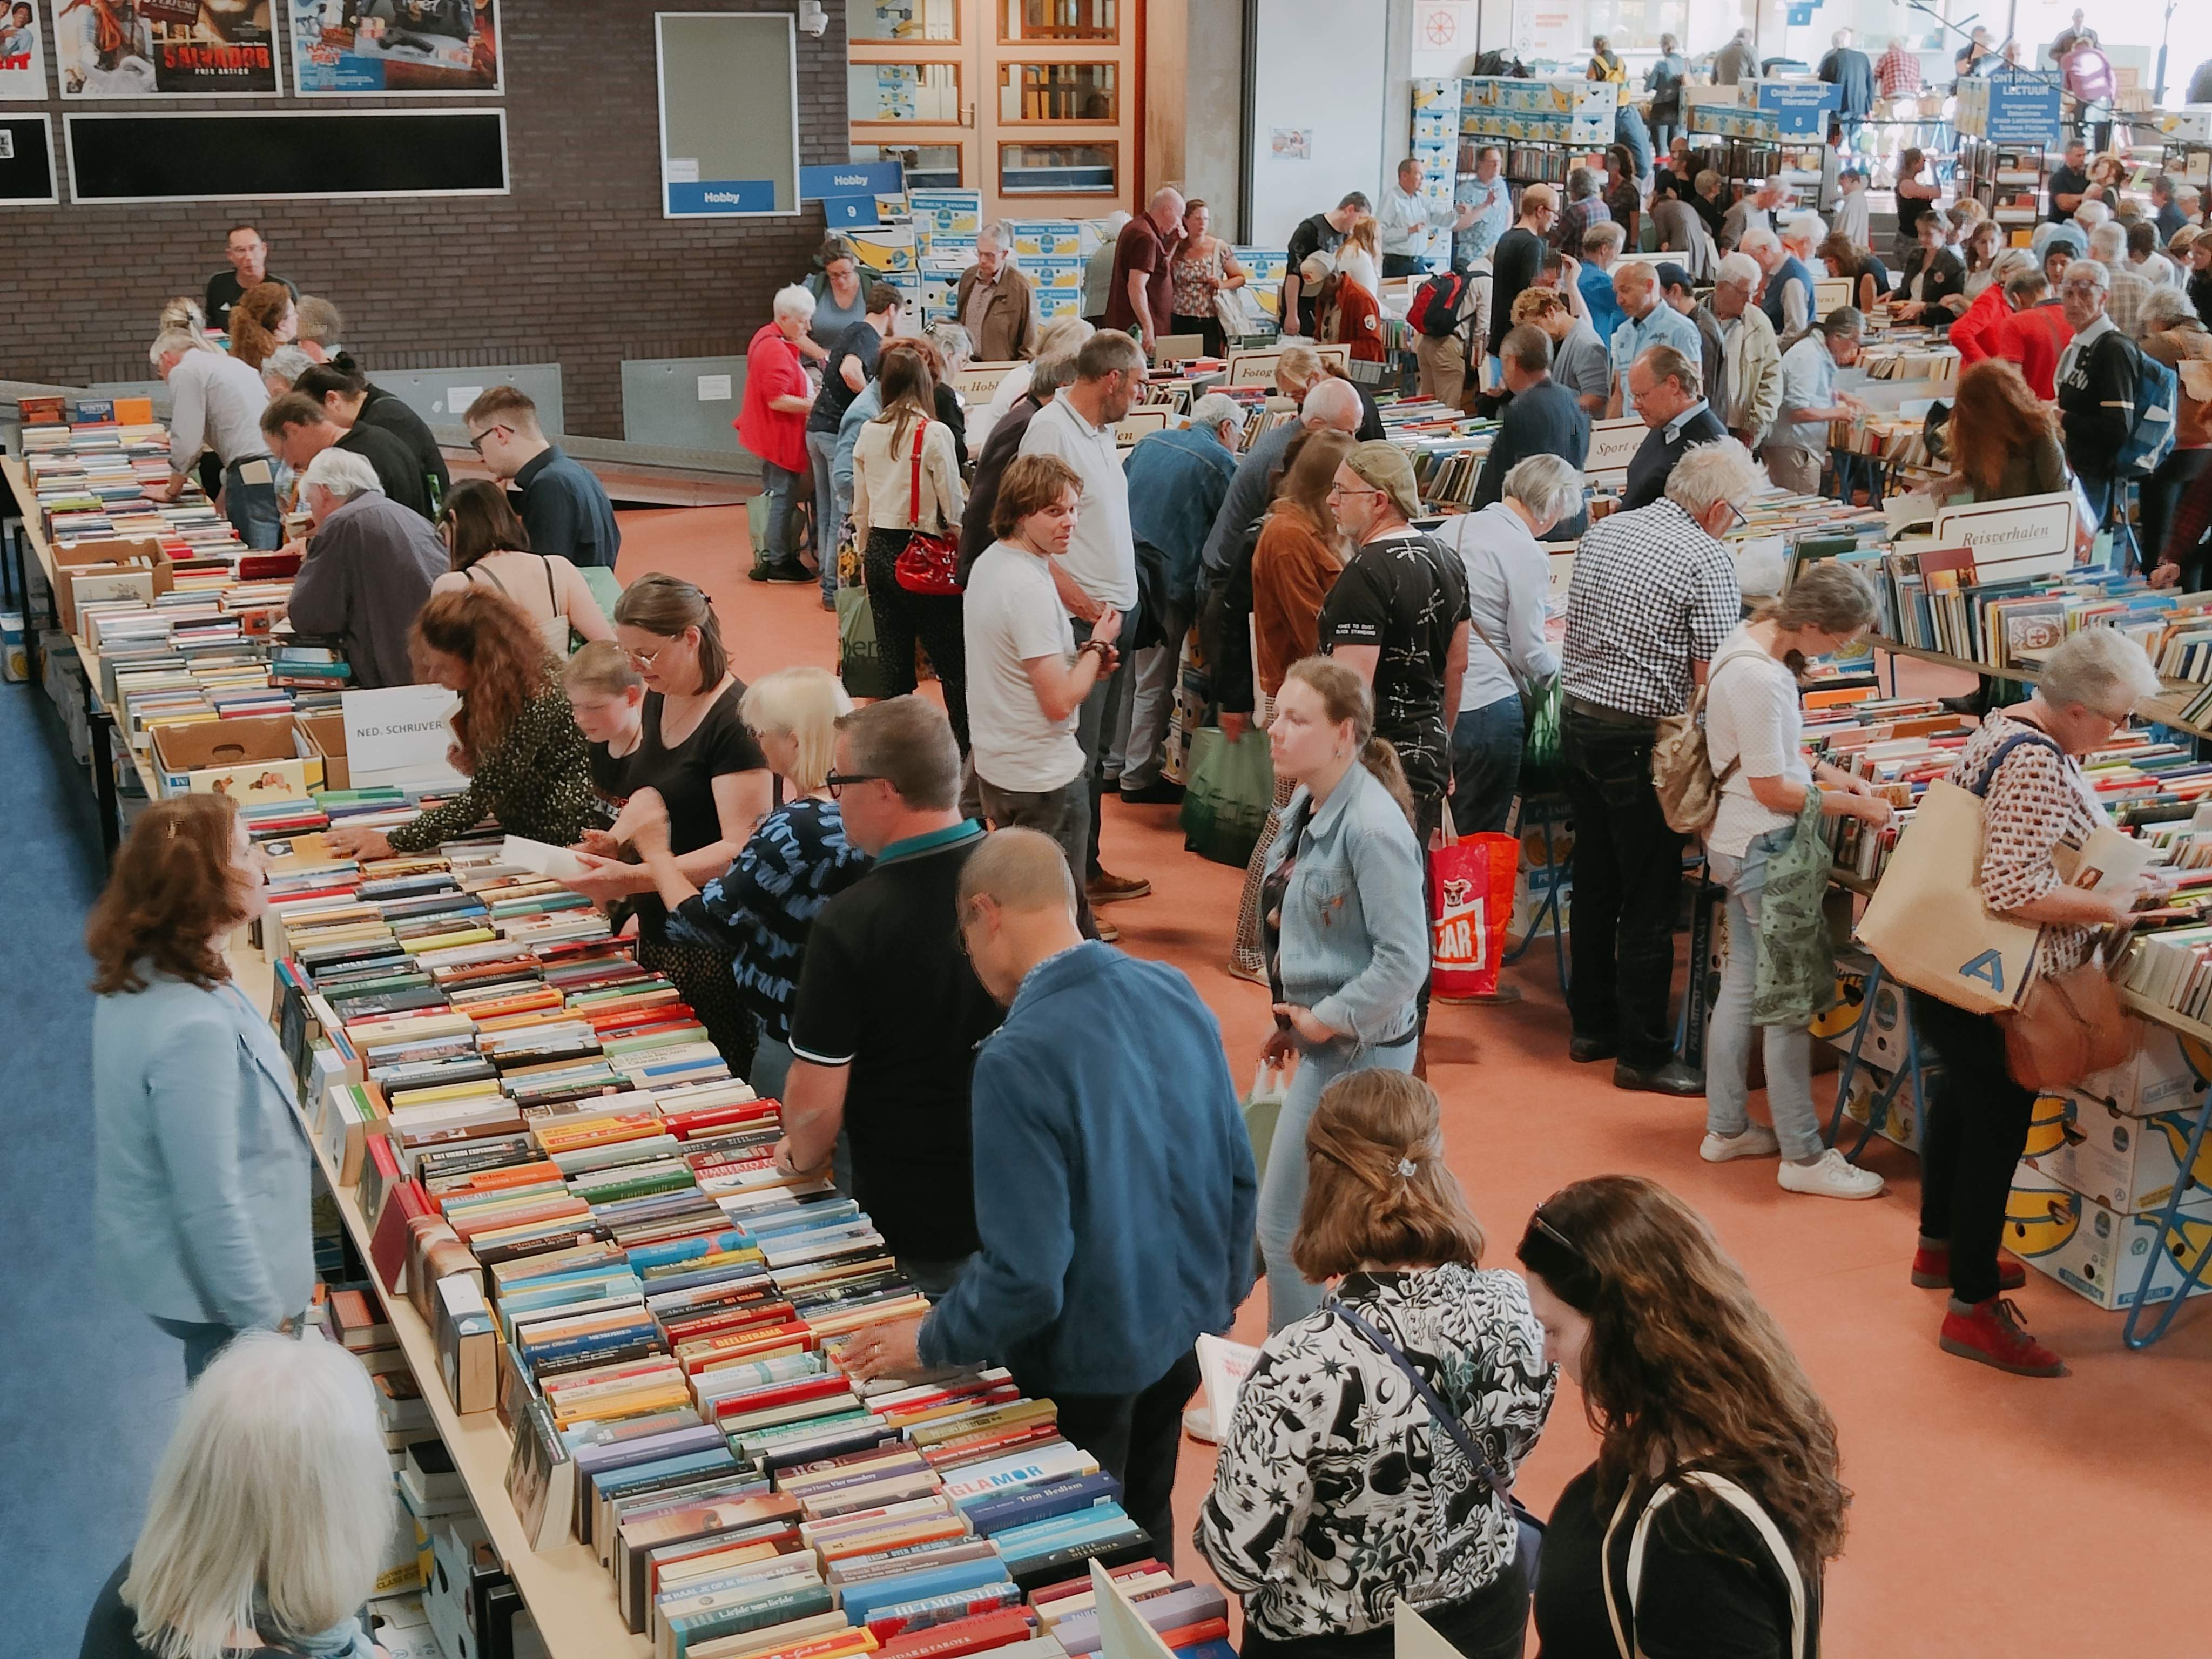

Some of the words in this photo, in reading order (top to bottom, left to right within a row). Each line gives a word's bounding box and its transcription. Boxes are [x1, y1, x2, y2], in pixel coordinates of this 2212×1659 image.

[834, 174, 868, 186] Hobby
[704, 192, 740, 204] Hobby
[847, 205, 857, 217] 9
[1241, 367, 1275, 380] Fotog
[1597, 441, 1629, 455] Sport
[1962, 523, 2049, 547] Reisverhalen
[356, 727, 383, 738] NED.
[386, 721, 442, 734] SCHRIJVER
[1437, 919, 1472, 959] ZAR
[698, 1161, 759, 1176] UMBERTO
[686, 1301, 720, 1312] Garland
[715, 1328, 783, 1348] DEELDERAMA
[830, 1479, 846, 1487] Vier
[1017, 1494, 1042, 1503] Tom
[1043, 1482, 1083, 1497] Bedlam
[673, 1587, 699, 1598] HAAL
[699, 1585, 711, 1593] JE
[711, 1582, 725, 1591] OP,
[725, 1580, 736, 1588] IK
[718, 1605, 751, 1619] Liefde
[767, 1595, 794, 1607] liefde
[894, 1603, 931, 1617] HET
[931, 1586, 1010, 1609] MONSTER
[929, 1636, 972, 1651] FAROEK
